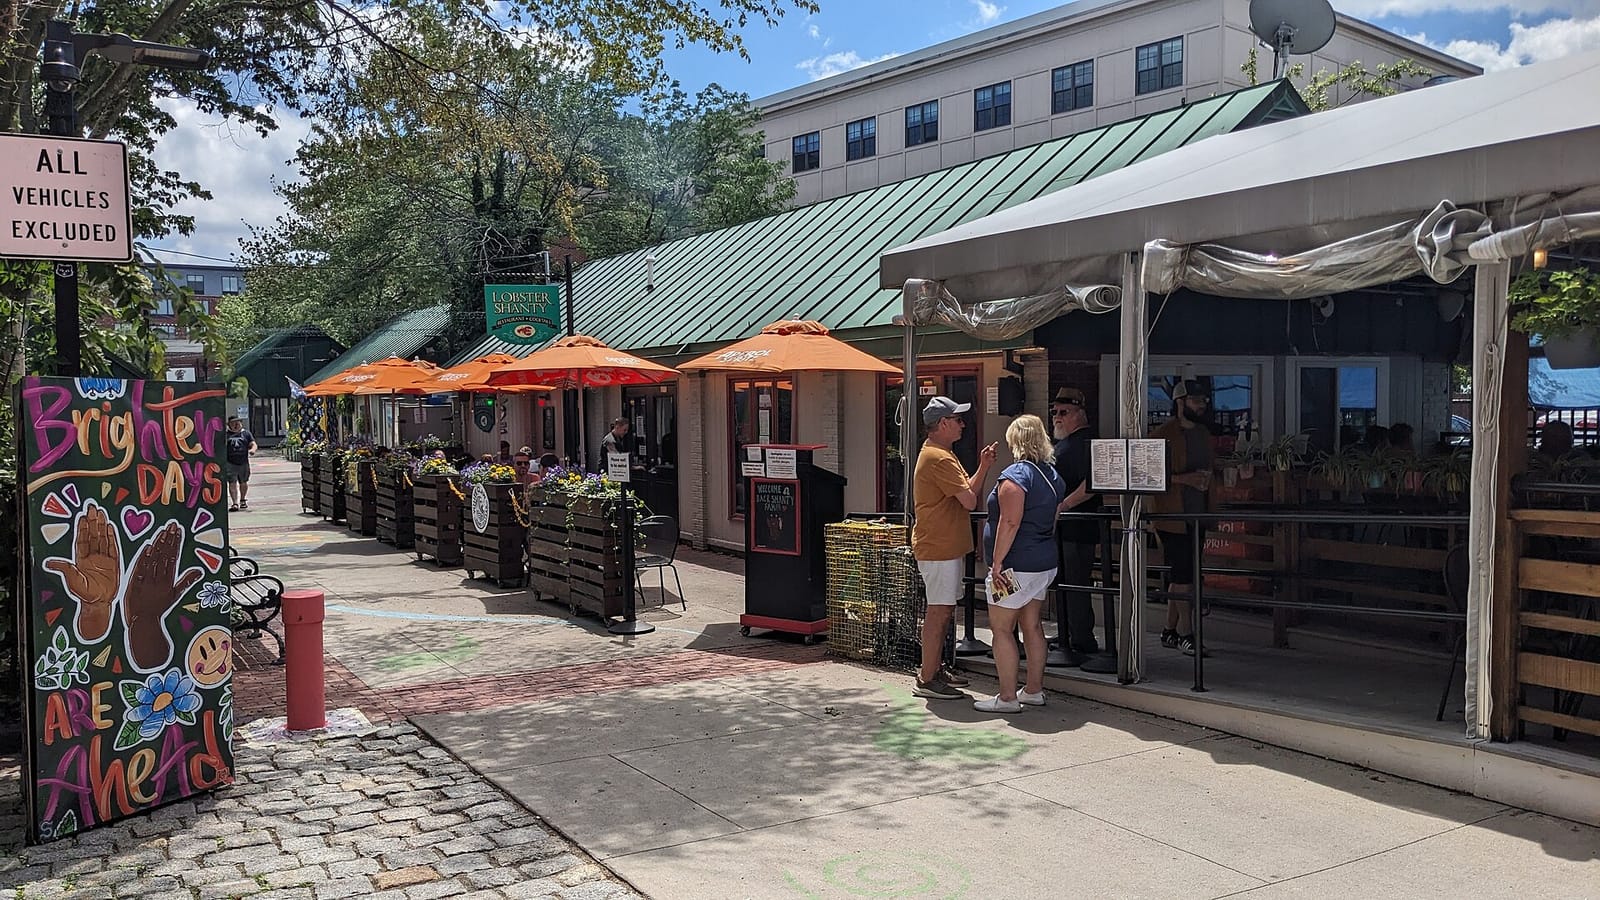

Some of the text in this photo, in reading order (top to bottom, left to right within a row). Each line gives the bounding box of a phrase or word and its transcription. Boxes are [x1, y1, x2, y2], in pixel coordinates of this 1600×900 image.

[36, 149, 87, 175] ALL
[12, 186, 110, 209] VEHICLES
[12, 220, 116, 242] EXCLUDED
[492, 291, 552, 304] LOBSTER
[494, 302, 547, 314] SHANTY
[22, 376, 226, 495] Brighter
[136, 460, 222, 509] DAYS
[44, 681, 114, 746] ARE
